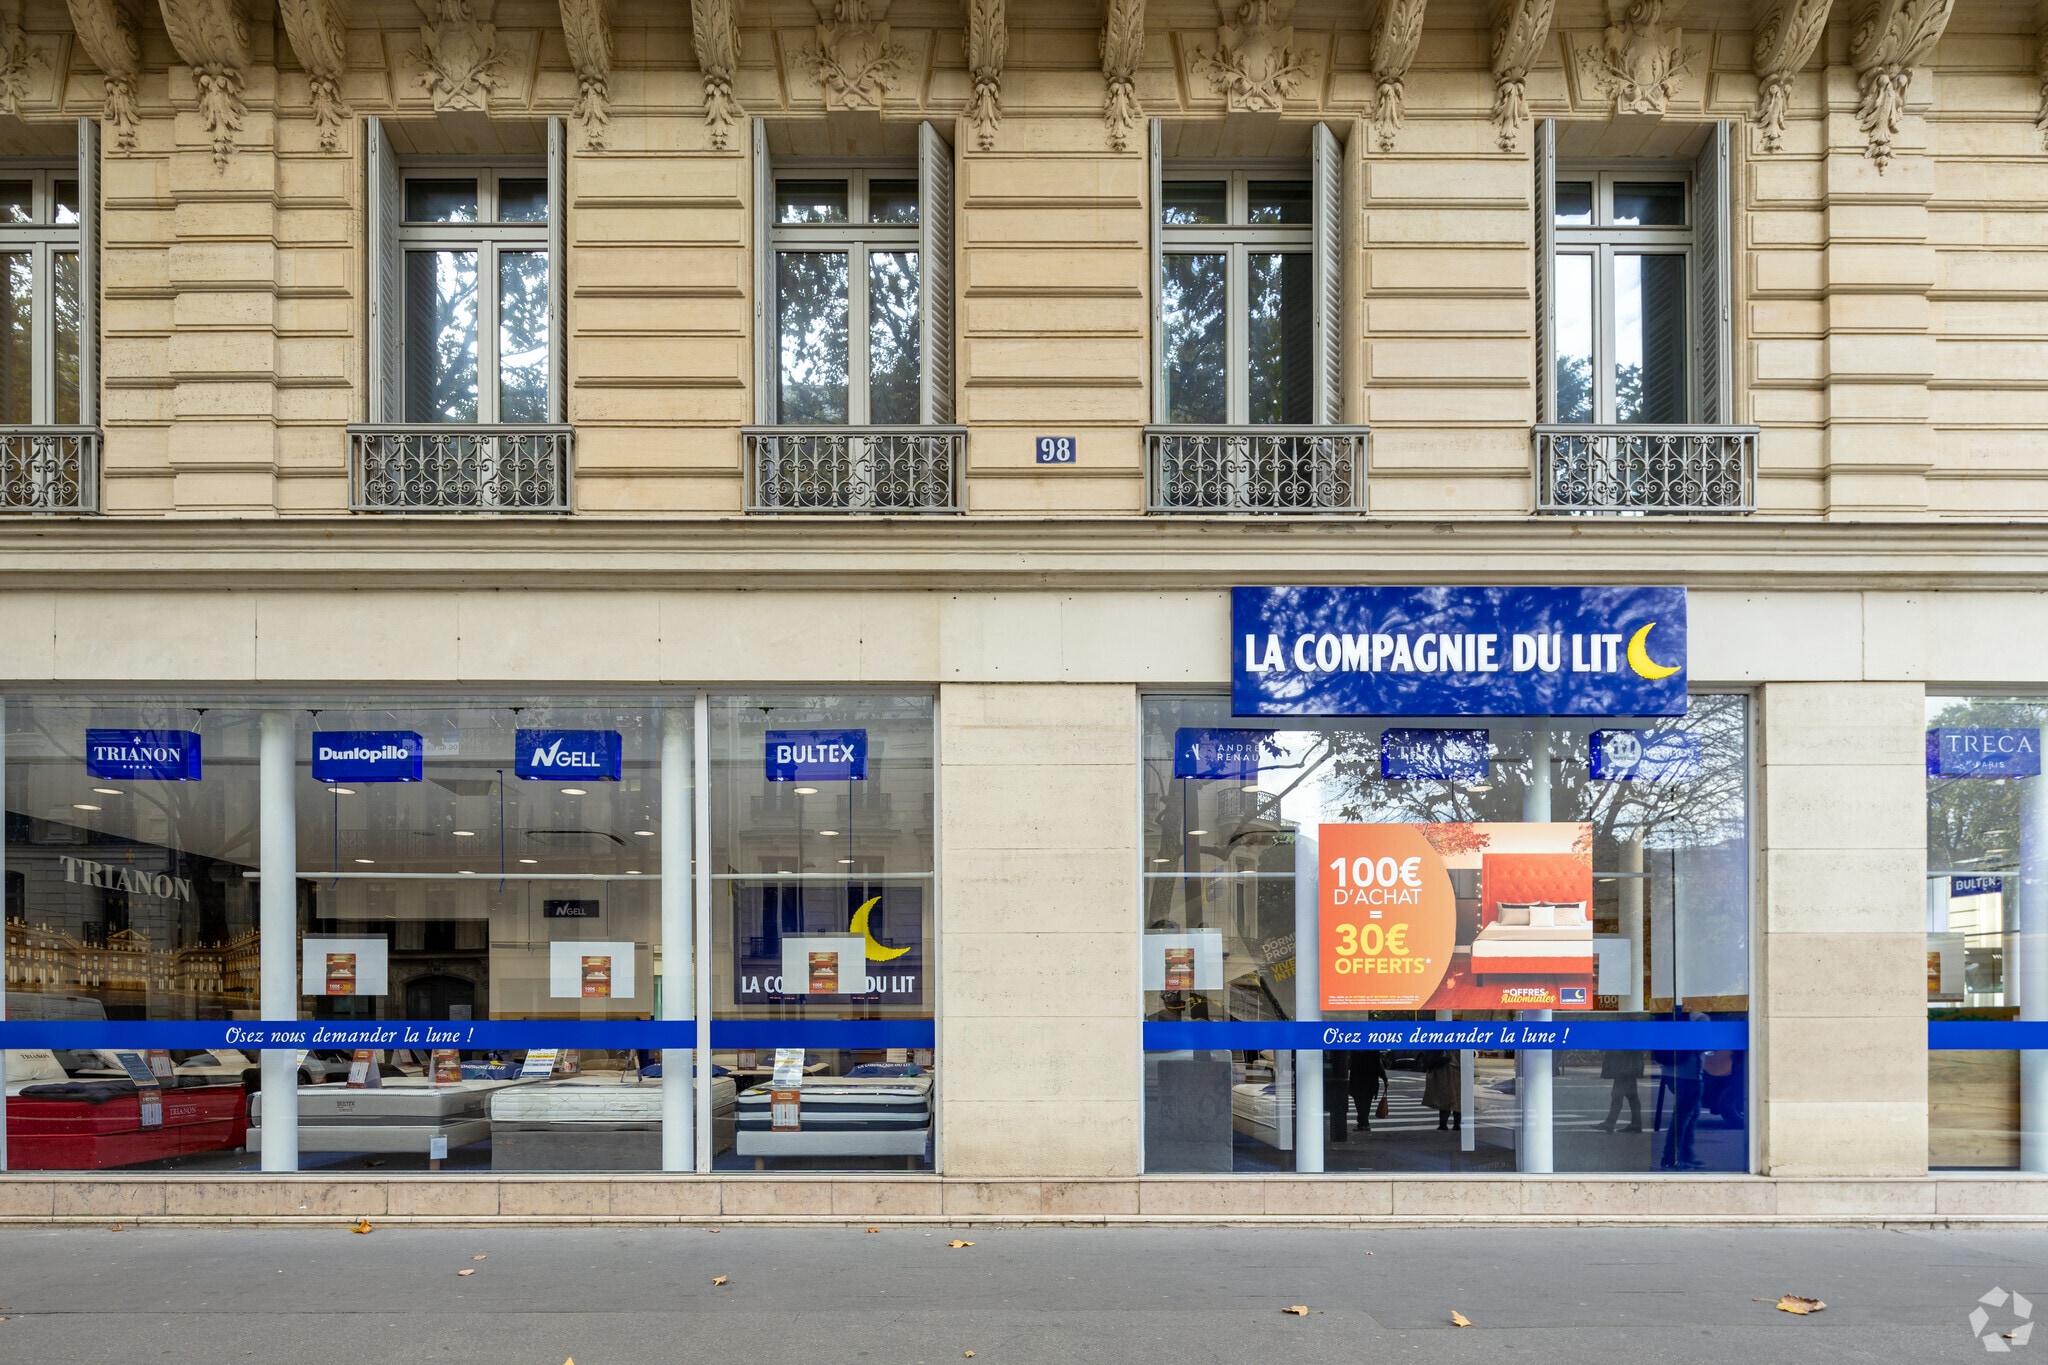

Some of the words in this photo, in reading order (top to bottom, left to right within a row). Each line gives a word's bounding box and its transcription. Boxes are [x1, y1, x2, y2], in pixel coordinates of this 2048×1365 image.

[1041, 438, 1070, 461] 98
[1245, 633, 1285, 672] LA
[1294, 633, 1498, 673] COMPAGNIE
[1512, 633, 1561, 673] DU
[1572, 633, 1622, 672] LIT
[531, 738, 600, 767] NGELL
[1945, 735, 2033, 753] TRECA
[94, 746, 181, 762] TRIANON
[319, 745, 409, 763] Dunlopillo
[777, 744, 854, 764] BULTEX
[59, 855, 191, 903] TRIANON
[1330, 856, 1423, 888] 100€
[1334, 888, 1422, 905] D'ACHAT
[555, 901, 587, 916] NGELL
[1335, 923, 1410, 956] 30€
[741, 975, 760, 993] LA
[866, 975, 887, 993] DU
[892, 975, 915, 993] LIT
[1509, 988, 1546, 996] OFFRES
[1501, 991, 1557, 1004] Automnales
[225, 1026, 264, 1044] Osez
[270, 1031, 306, 1043] nous
[312, 1027, 397, 1043] demander
[404, 1027, 420, 1043] la
[426, 1026, 460, 1043] lune
[466, 1027, 474, 1043] !
[1323, 1027, 1362, 1044] Osez
[1368, 1032, 1403, 1044] nous
[1409, 1027, 1494, 1044] demander
[1500, 1027, 1515, 1043] la
[1521, 1027, 1556, 1043] lune
[1562, 1027, 1570, 1044] !
